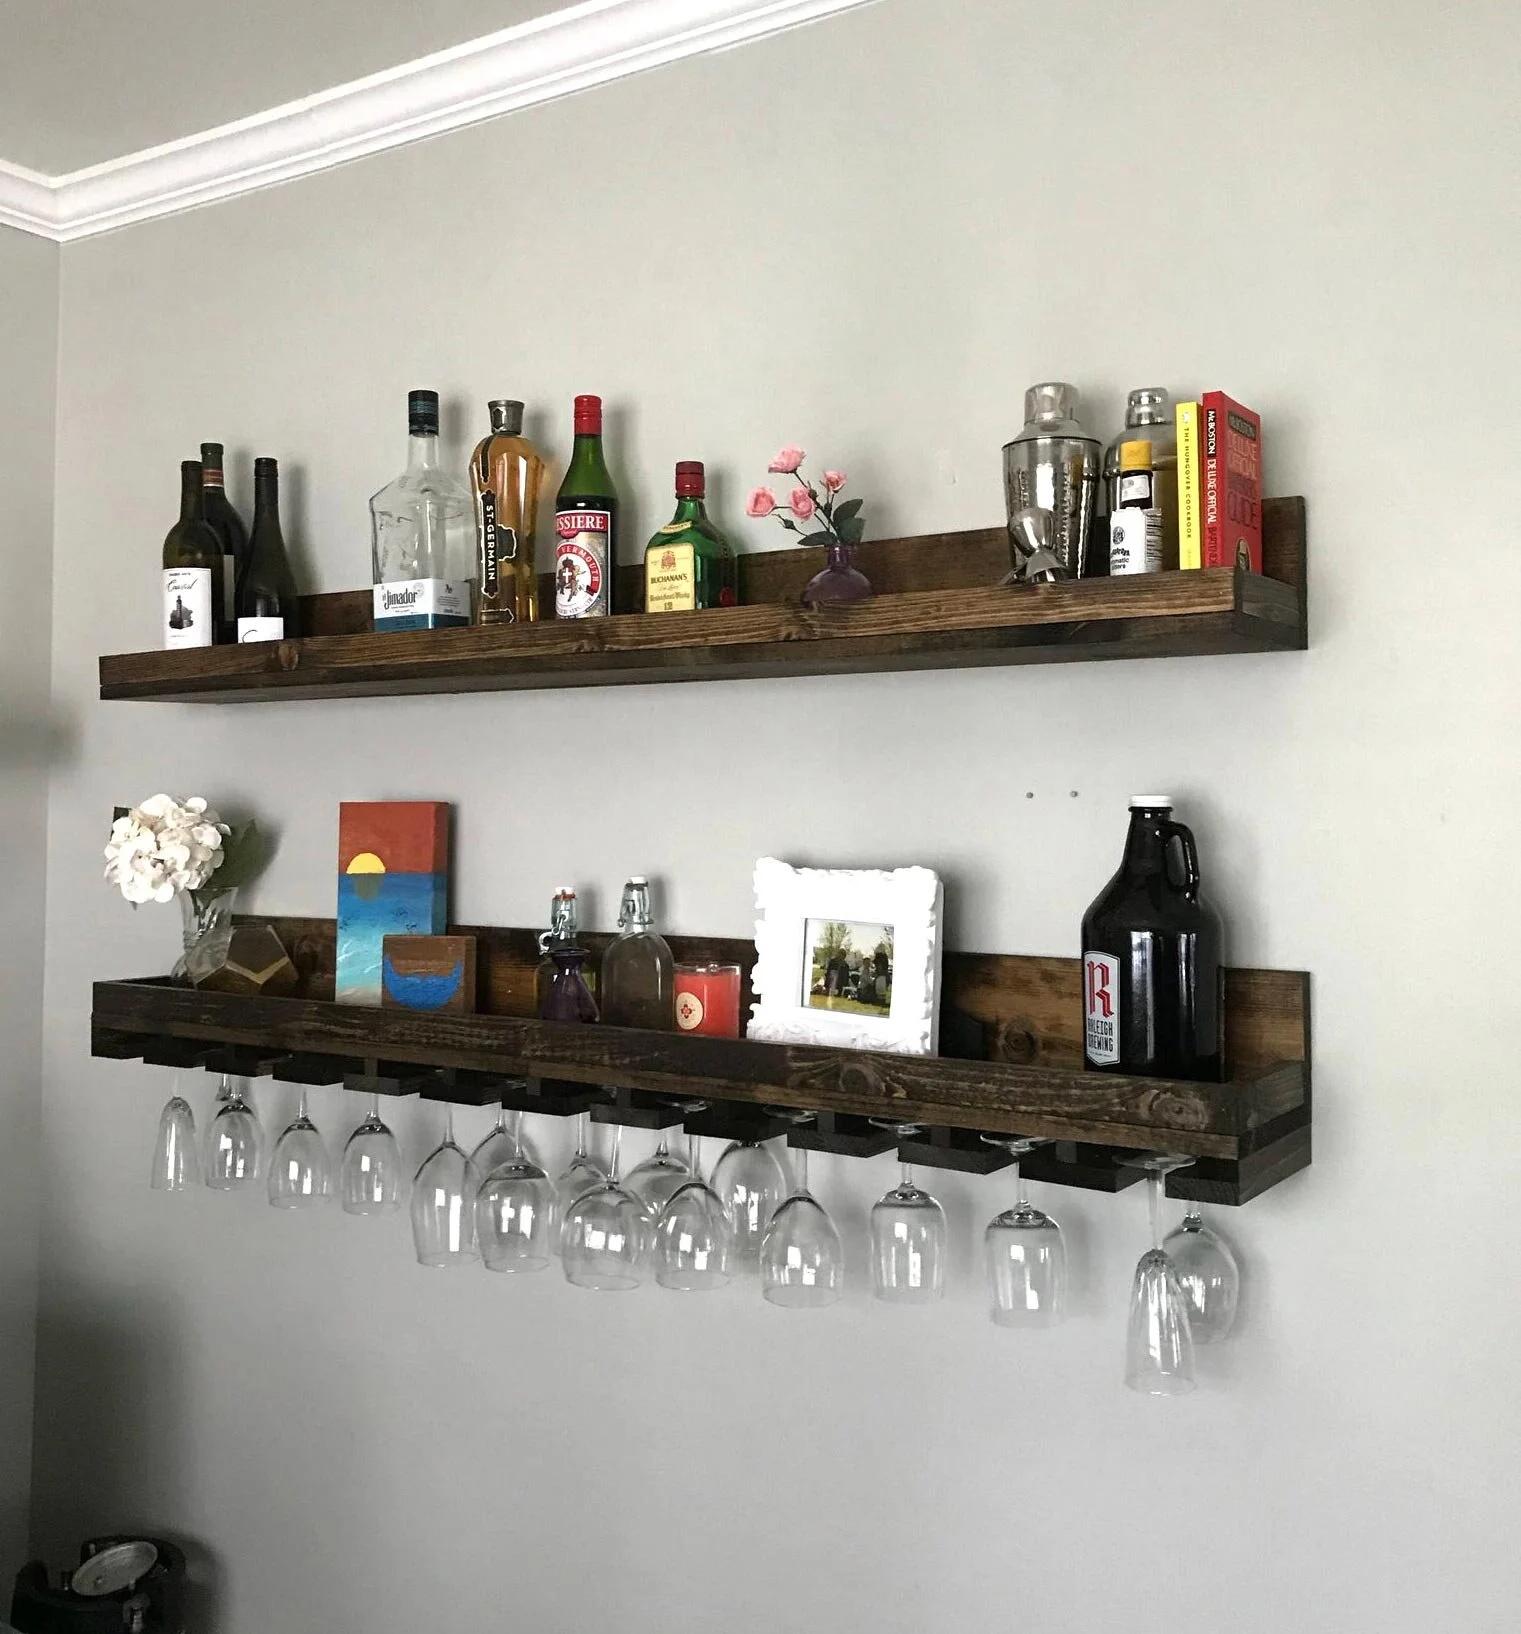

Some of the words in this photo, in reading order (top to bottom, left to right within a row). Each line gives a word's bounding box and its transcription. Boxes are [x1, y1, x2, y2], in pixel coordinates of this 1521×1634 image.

[1207, 422, 1216, 455] BOSTON
[486, 505, 496, 580] ST-GERMAIN
[561, 546, 599, 582] VERMOUTH
[651, 573, 688, 585] BUCHANAN'S
[384, 588, 418, 610] Jimador
